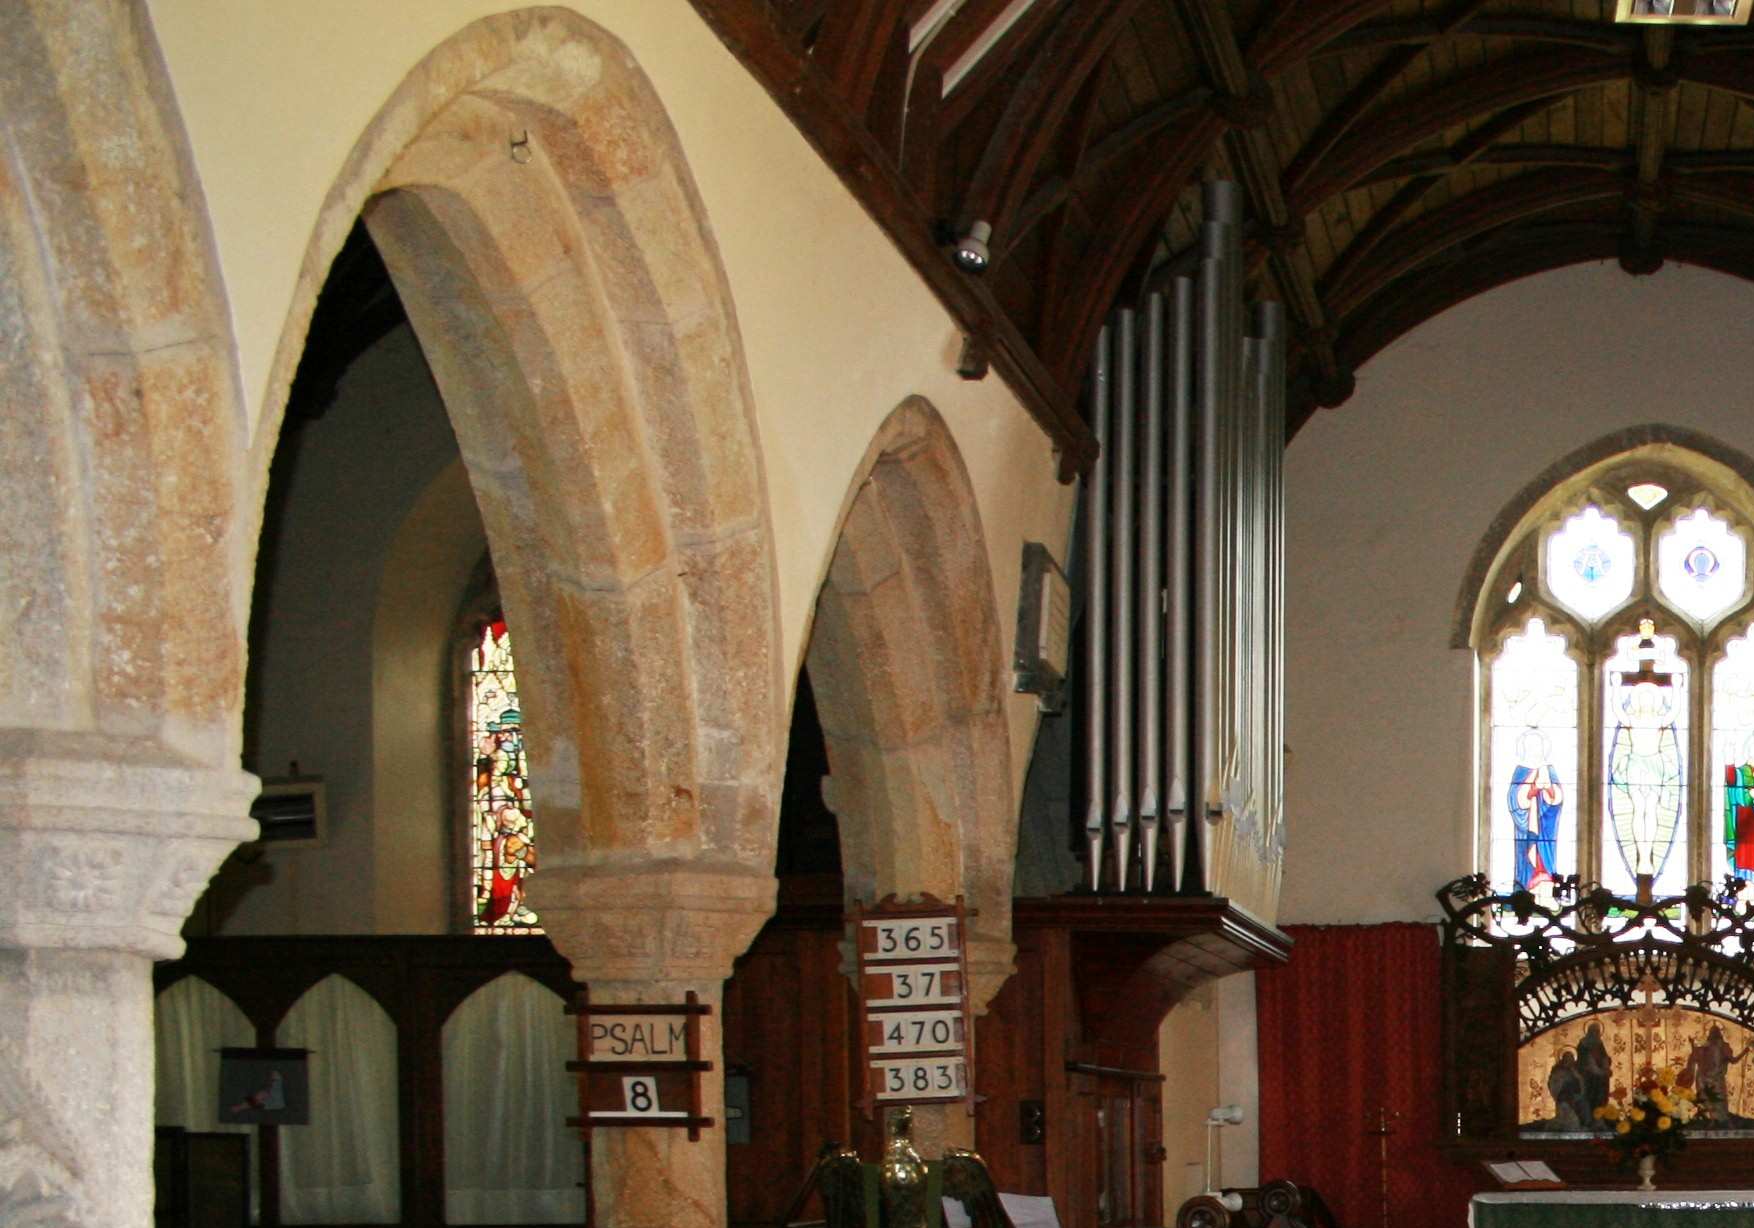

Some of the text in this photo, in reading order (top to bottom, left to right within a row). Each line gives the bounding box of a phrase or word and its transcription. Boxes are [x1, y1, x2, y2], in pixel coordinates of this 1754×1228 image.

[881, 926, 944, 952] 365
[896, 973, 935, 999] 37
[590, 1023, 688, 1055] PSALM
[887, 1020, 950, 1044] 470
[889, 1066, 953, 1092] 383
[631, 1081, 652, 1112] 8
